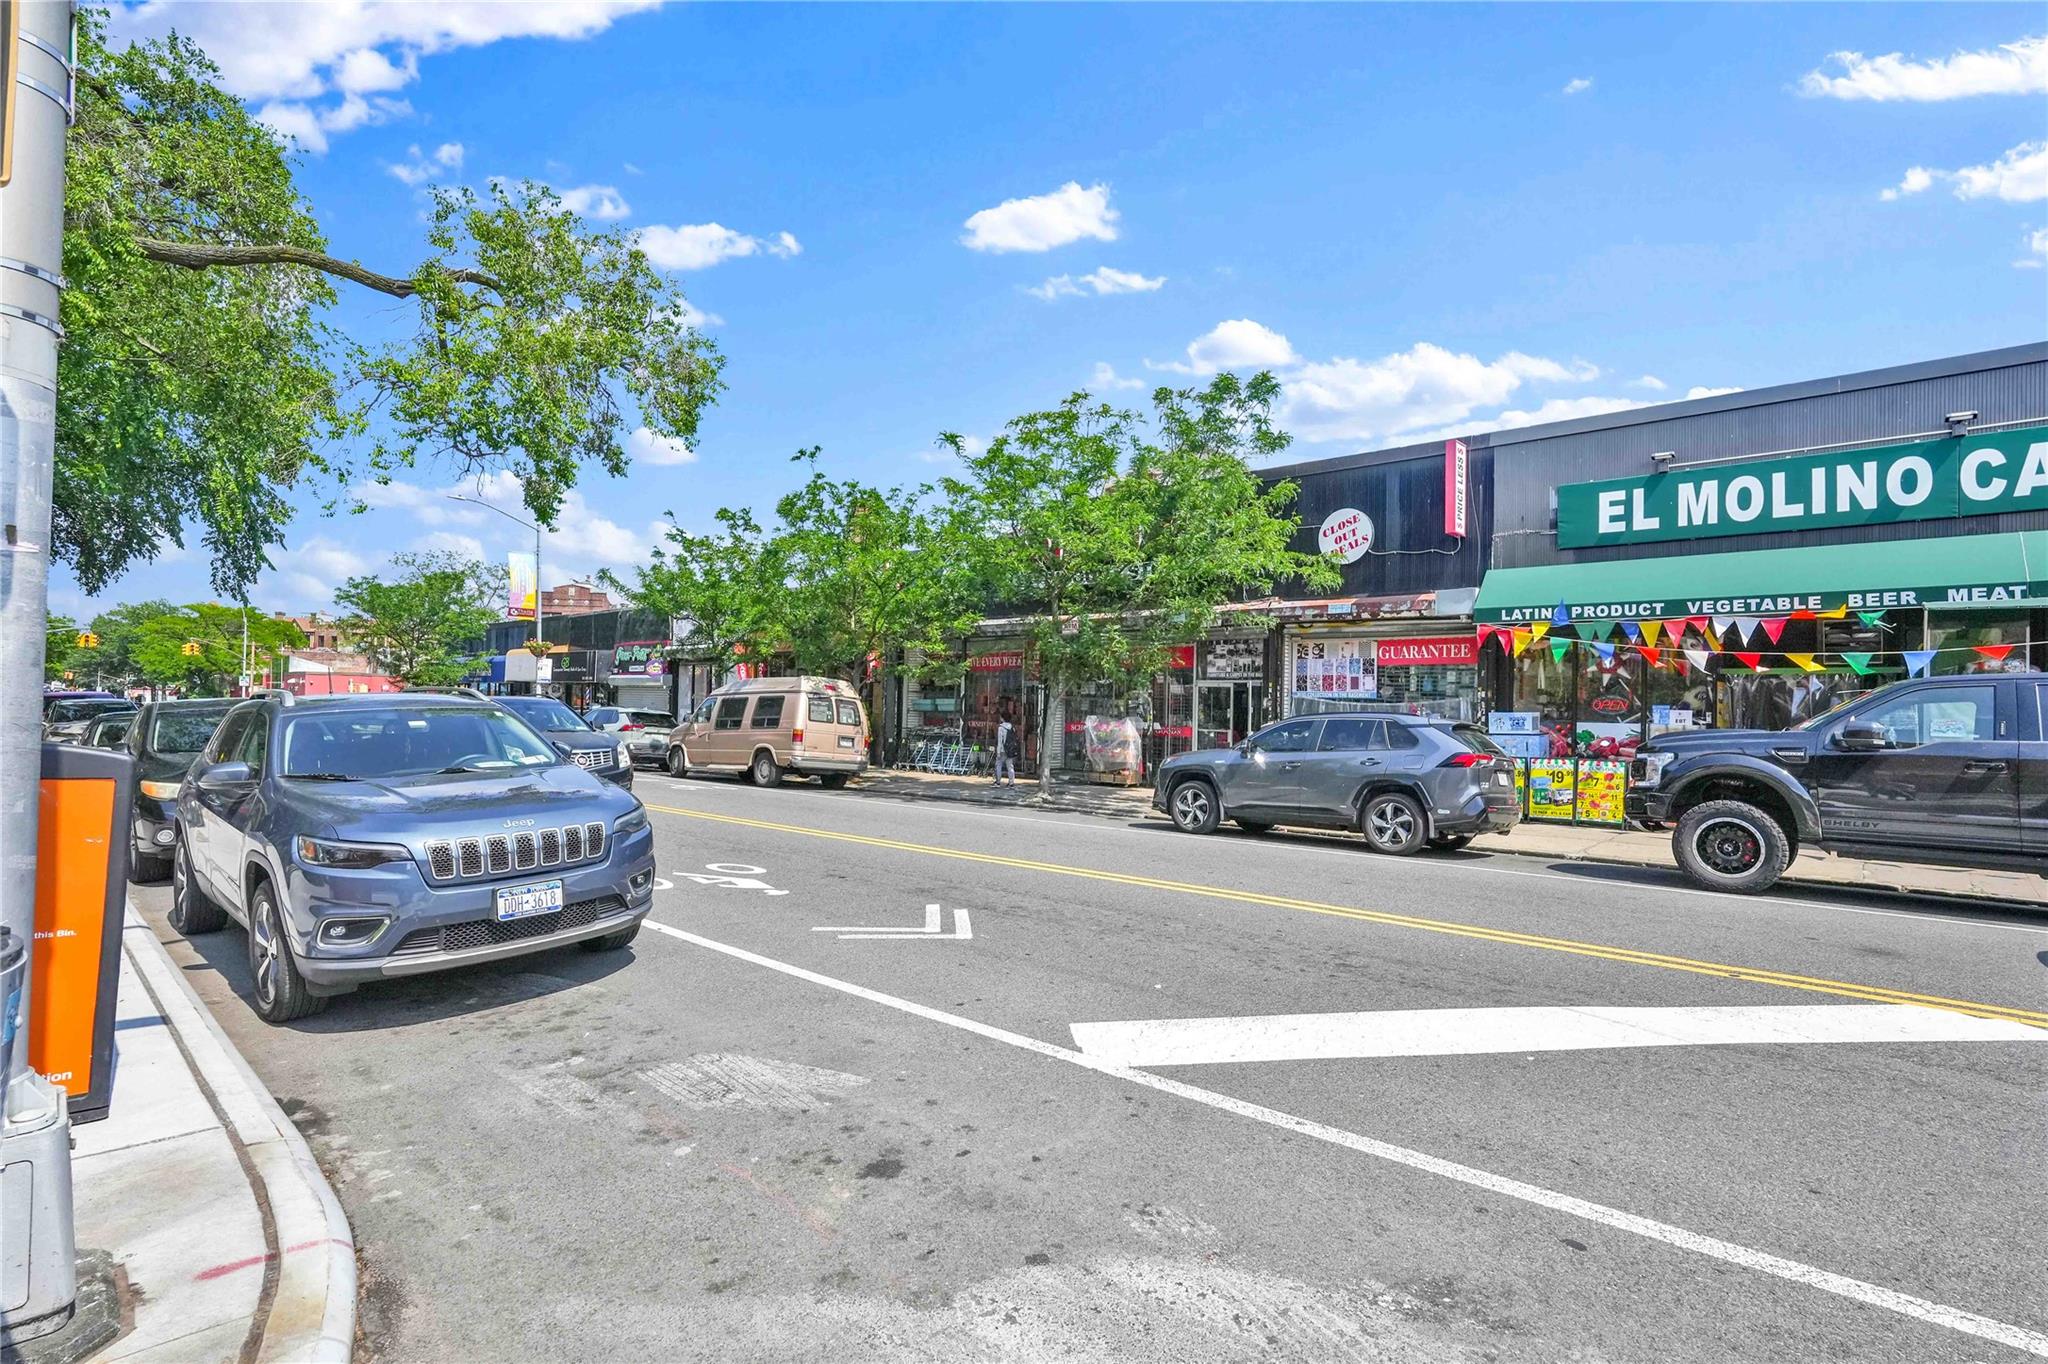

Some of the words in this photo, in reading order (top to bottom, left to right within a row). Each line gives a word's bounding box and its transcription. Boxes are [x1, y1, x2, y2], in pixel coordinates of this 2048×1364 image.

[1599, 488, 1660, 534] EL
[1677, 456, 1934, 528] MOLINO
[1322, 513, 1361, 538] CLOSE
[1334, 527, 1358, 545] OUT
[1571, 602, 1665, 619] PRODUCT
[1687, 595, 1822, 614] VEGETABLE
[1847, 591, 1918, 607] BEER
[1947, 585, 2027, 602] MEAT
[1378, 643, 1472, 660] GUARANTEE
[1592, 698, 1629, 712] OPEN
[503, 818, 535, 828] Jeep
[1823, 819, 1880, 829] SHELBY
[34, 931, 53, 939] this
[56, 929, 77, 938] Bin.
